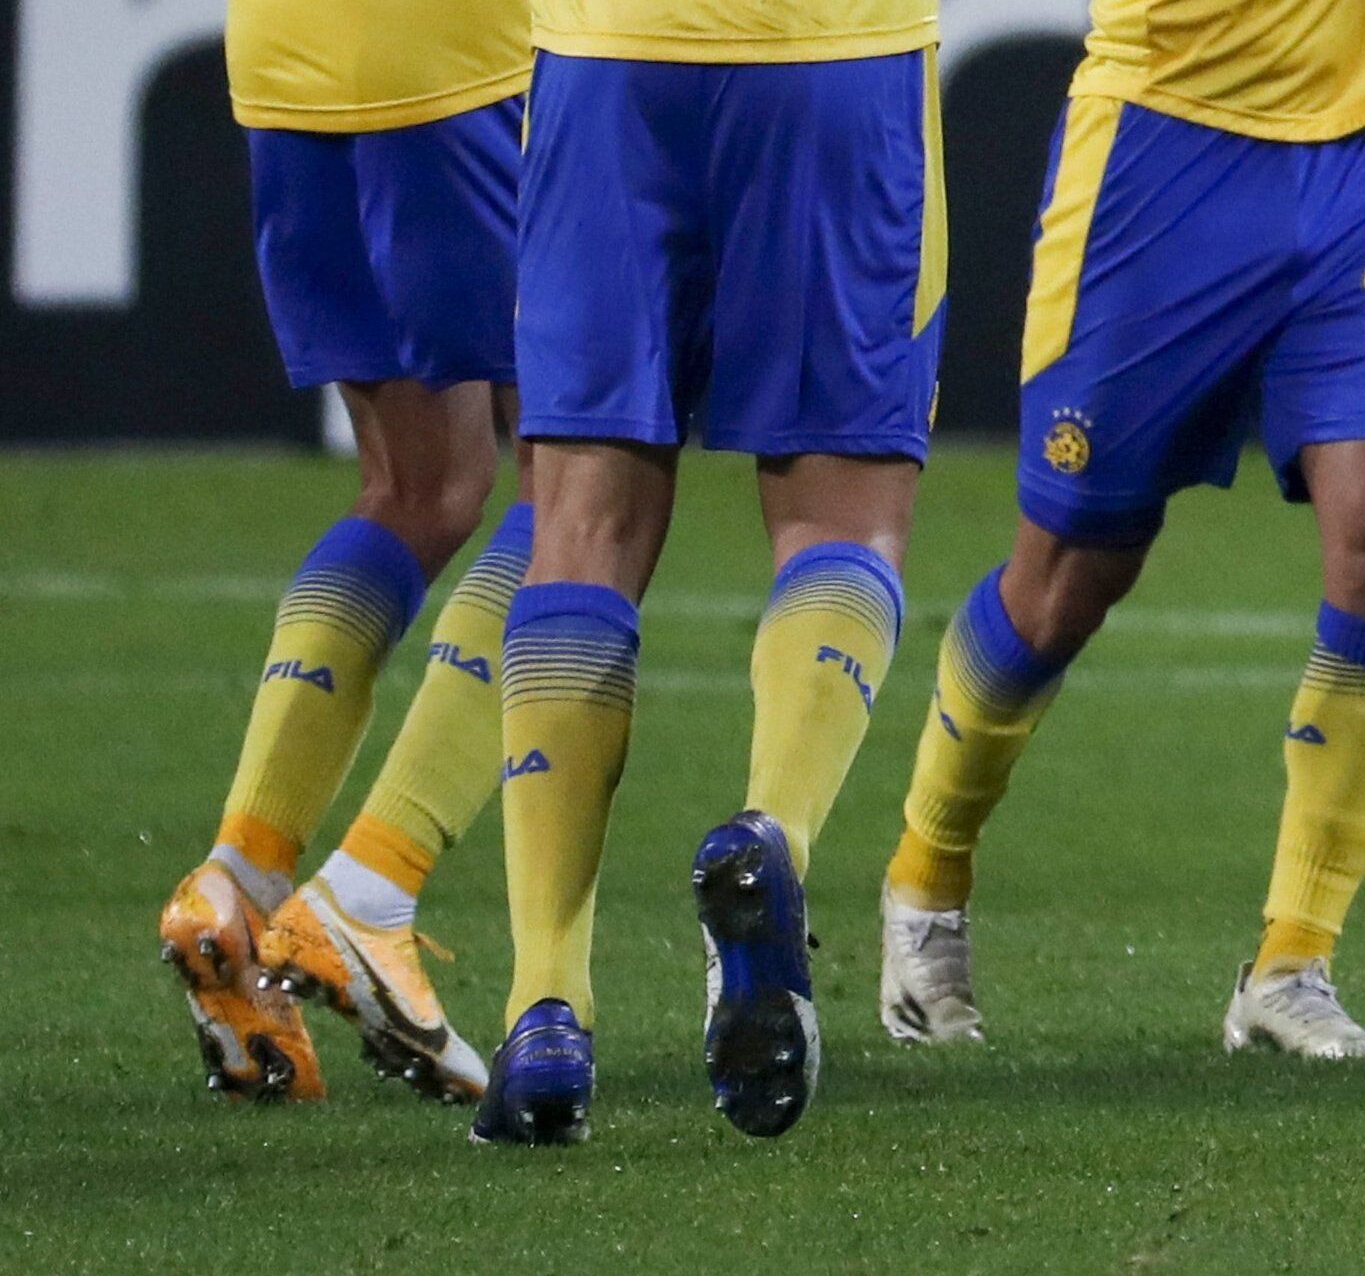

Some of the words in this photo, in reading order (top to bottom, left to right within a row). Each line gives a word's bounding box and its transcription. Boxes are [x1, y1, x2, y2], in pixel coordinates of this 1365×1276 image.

[265, 659, 335, 694] FILA
[428, 642, 492, 684] FILA
[816, 645, 872, 715] FILA
